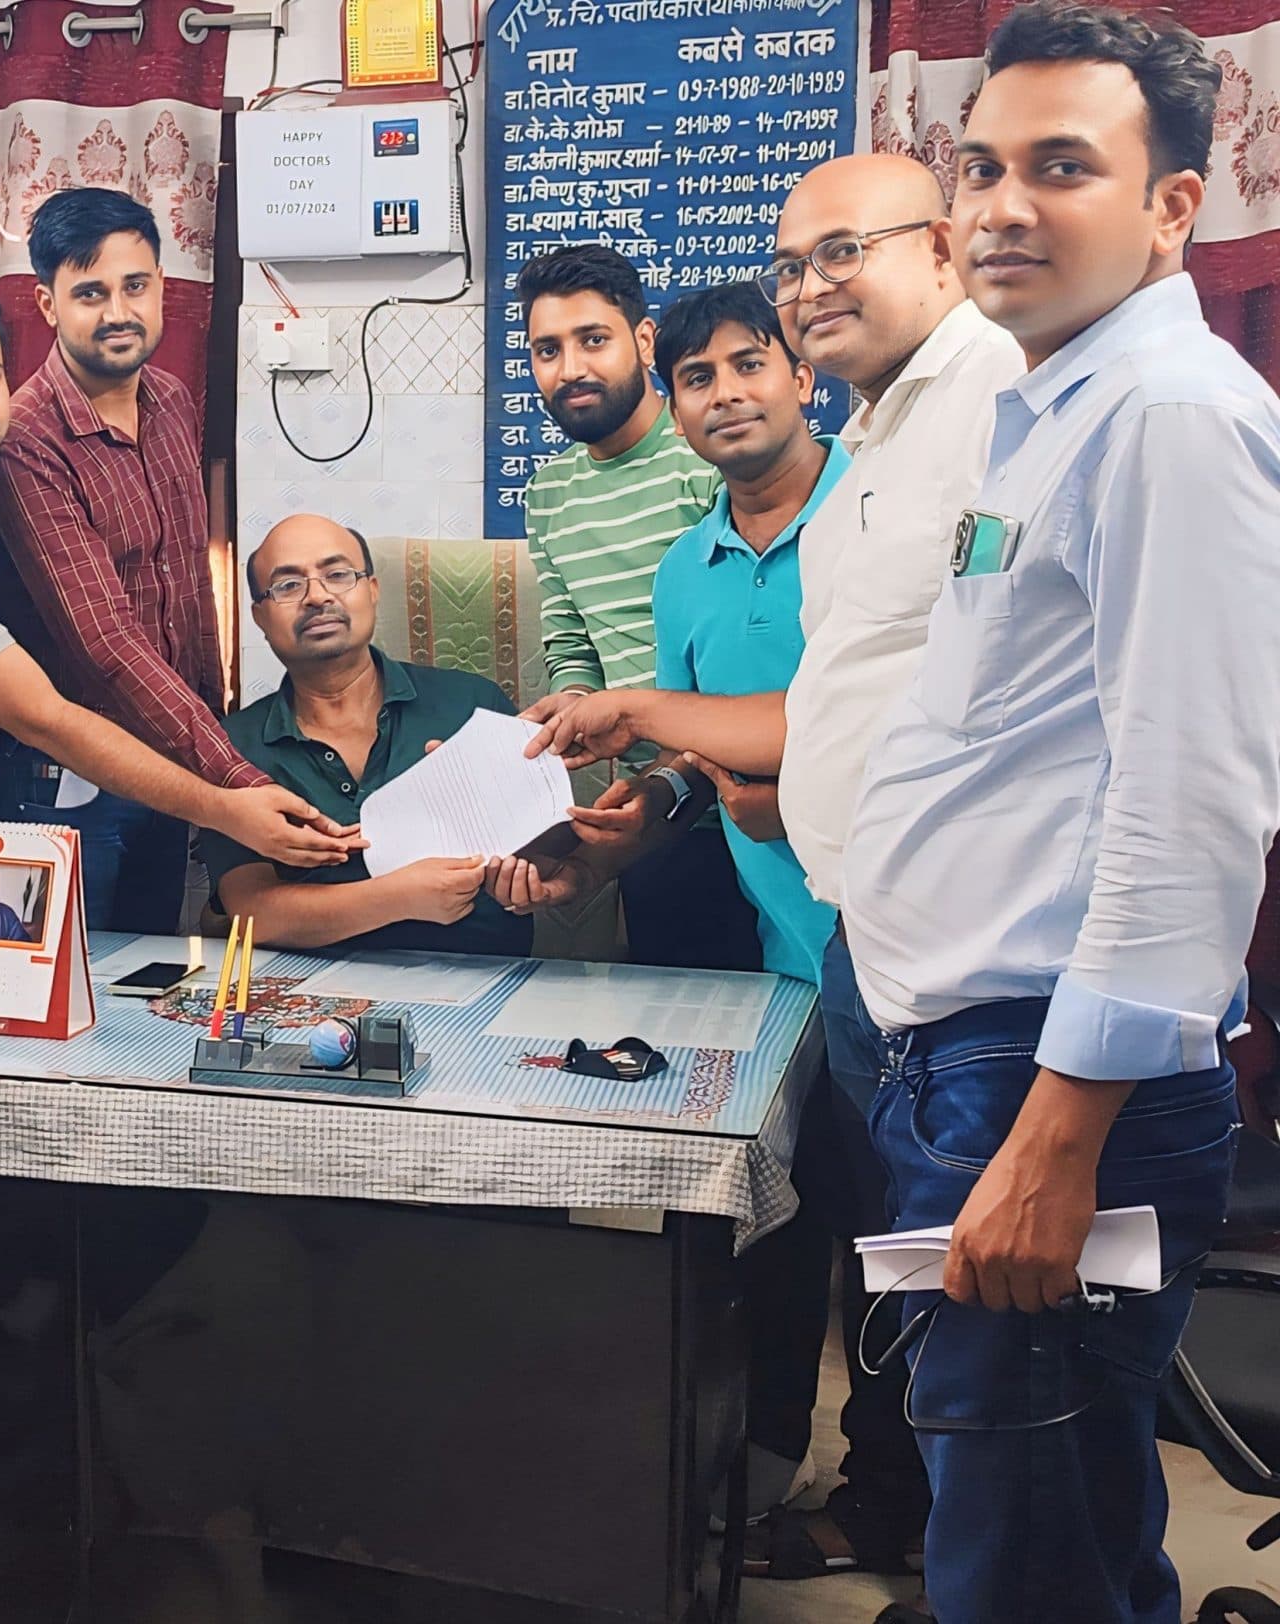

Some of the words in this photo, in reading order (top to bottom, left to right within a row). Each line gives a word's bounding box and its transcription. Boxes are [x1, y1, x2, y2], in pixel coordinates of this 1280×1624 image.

[527, 48, 578, 75] नाम
[591, 82, 647, 115] कुमार
[283, 131, 323, 143] HAPPY
[756, 139, 836, 164] 11-01-2001
[273, 155, 331, 167] DOCTORS
[289, 179, 315, 191] DAY
[266, 202, 336, 215] 01/07/2024
